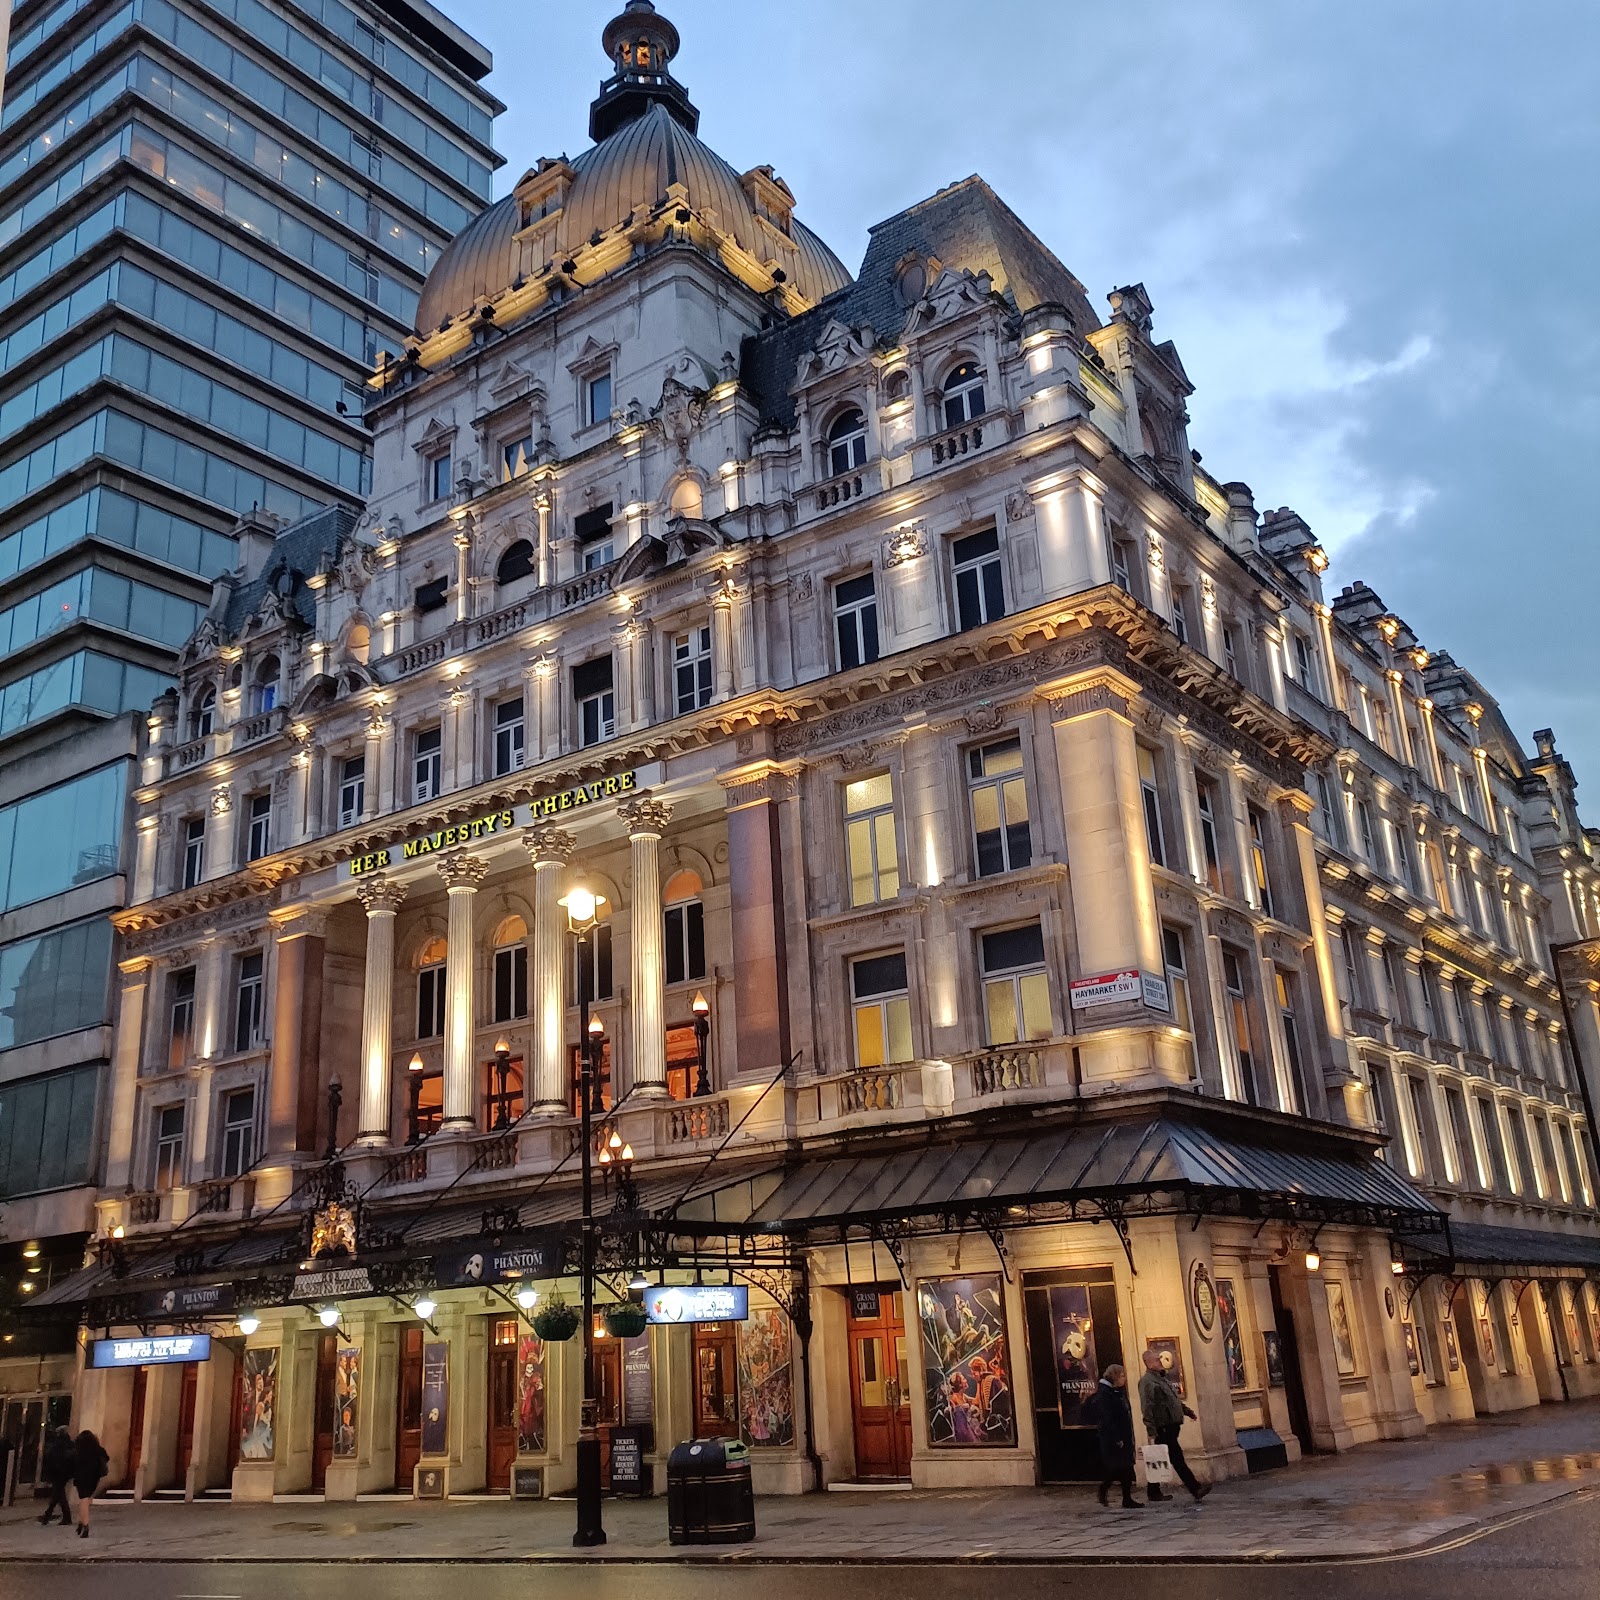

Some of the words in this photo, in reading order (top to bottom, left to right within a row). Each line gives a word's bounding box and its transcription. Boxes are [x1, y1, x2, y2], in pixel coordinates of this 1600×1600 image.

[350, 850, 390, 876] HER
[403, 810, 515, 859] MAJESTY'S
[529, 771, 637, 819] THEATRE
[1075, 984, 1117, 999] HAYMARKET
[1118, 982, 1134, 992] SW1
[494, 1252, 543, 1270] PHANTOM
[183, 1290, 219, 1305] PHANTOM
[856, 1293, 876, 1302] GRAND
[153, 1347, 168, 1356] ALL
[625, 1363, 650, 1371] PHANTOM
[1062, 1381, 1096, 1390] PHANTOM
